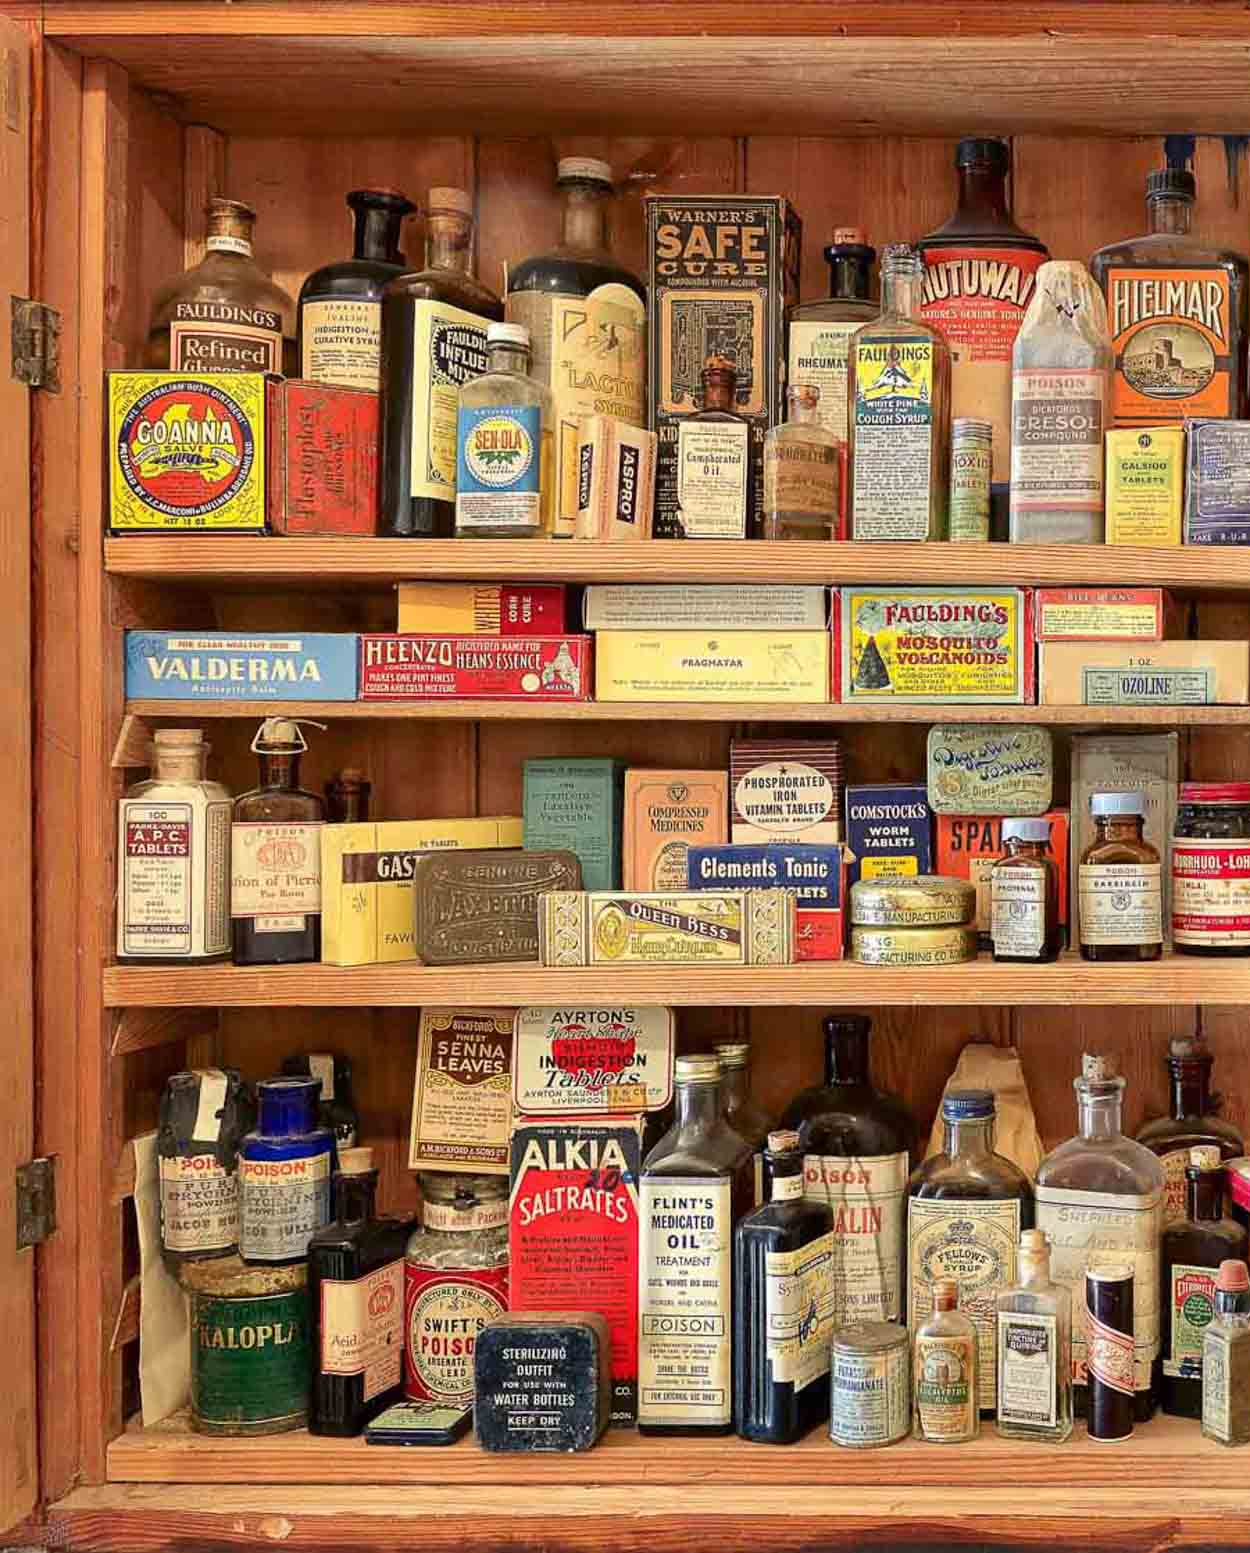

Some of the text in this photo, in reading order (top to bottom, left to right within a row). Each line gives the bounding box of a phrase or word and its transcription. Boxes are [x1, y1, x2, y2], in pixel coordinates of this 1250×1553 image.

[667, 211, 755, 223] WARNER'S
[656, 225, 767, 259] SAFE
[656, 262, 767, 276] CURE
[177, 303, 276, 328] FAULDING'S
[185, 339, 265, 365] Refined
[859, 346, 931, 362] FAULDING'S
[1027, 378, 1085, 388] POISON
[857, 413, 929, 424] COUGH SYRUP
[1015, 416, 1098, 429] CRESOL
[137, 421, 234, 444] GOANNA
[1024, 431, 1087, 440] COMPOUND
[164, 444, 202, 452] SALVE
[1122, 476, 1165, 484] TABLETS
[884, 603, 1009, 627] FAULDING'S
[896, 635, 999, 651] MOSQUITO
[367, 640, 453, 667] HEENZO
[897, 653, 1008, 666] VOLCANOIDS
[456, 653, 542, 670] HEANS ESSENCE
[681, 658, 743, 669] PRAGMATAR
[146, 656, 321, 681] VALDERMA
[744, 776, 825, 789] PHOSPHORATED
[773, 790, 797, 801] IRON
[149, 810, 167, 820] 100
[647, 807, 709, 818] COMPRESSED
[744, 802, 825, 816] VITAMIN TABLETS
[850, 803, 927, 820] COMSTOCK'S
[650, 819, 704, 832] MEDICINES
[868, 824, 910, 838] WORM
[132, 830, 182, 842] A.P.C.
[128, 844, 187, 855] TABLETS
[863, 837, 916, 849] TABLETS
[701, 857, 828, 878] Clements Tonic
[265, 875, 281, 887] of
[629, 902, 730, 941] QUEEN BESS
[552, 1011, 635, 1023] AYRTON'S
[437, 1041, 506, 1060] SENNA
[437, 1057, 503, 1073] LEAVES
[539, 1054, 647, 1069] INDIGESTION
[545, 1070, 640, 1089] Tablets
[520, 1139, 628, 1170] ALKIA
[242, 1161, 306, 1176] POISON
[519, 1187, 628, 1226] SALTRATES
[653, 1197, 714, 1210] FLINT'S
[652, 1215, 714, 1229] MEDICATED
[667, 1235, 700, 1249] OIL
[655, 1256, 711, 1267] TREATMENT
[937, 1249, 989, 1264] FELLOWS
[943, 1264, 981, 1273] SYRUP
[424, 1317, 485, 1333] SWIFT'S
[650, 1319, 715, 1332] POISON
[331, 1333, 358, 1347] Acid
[502, 1348, 567, 1360] STERILIZING
[440, 1368, 466, 1377] LEAD
[516, 1364, 553, 1376] OUTFIT
[503, 1381, 567, 1389] FOR USE WITH
[494, 1393, 575, 1406] WATER BOTTLES
[508, 1415, 561, 1426] KEEP DRY
